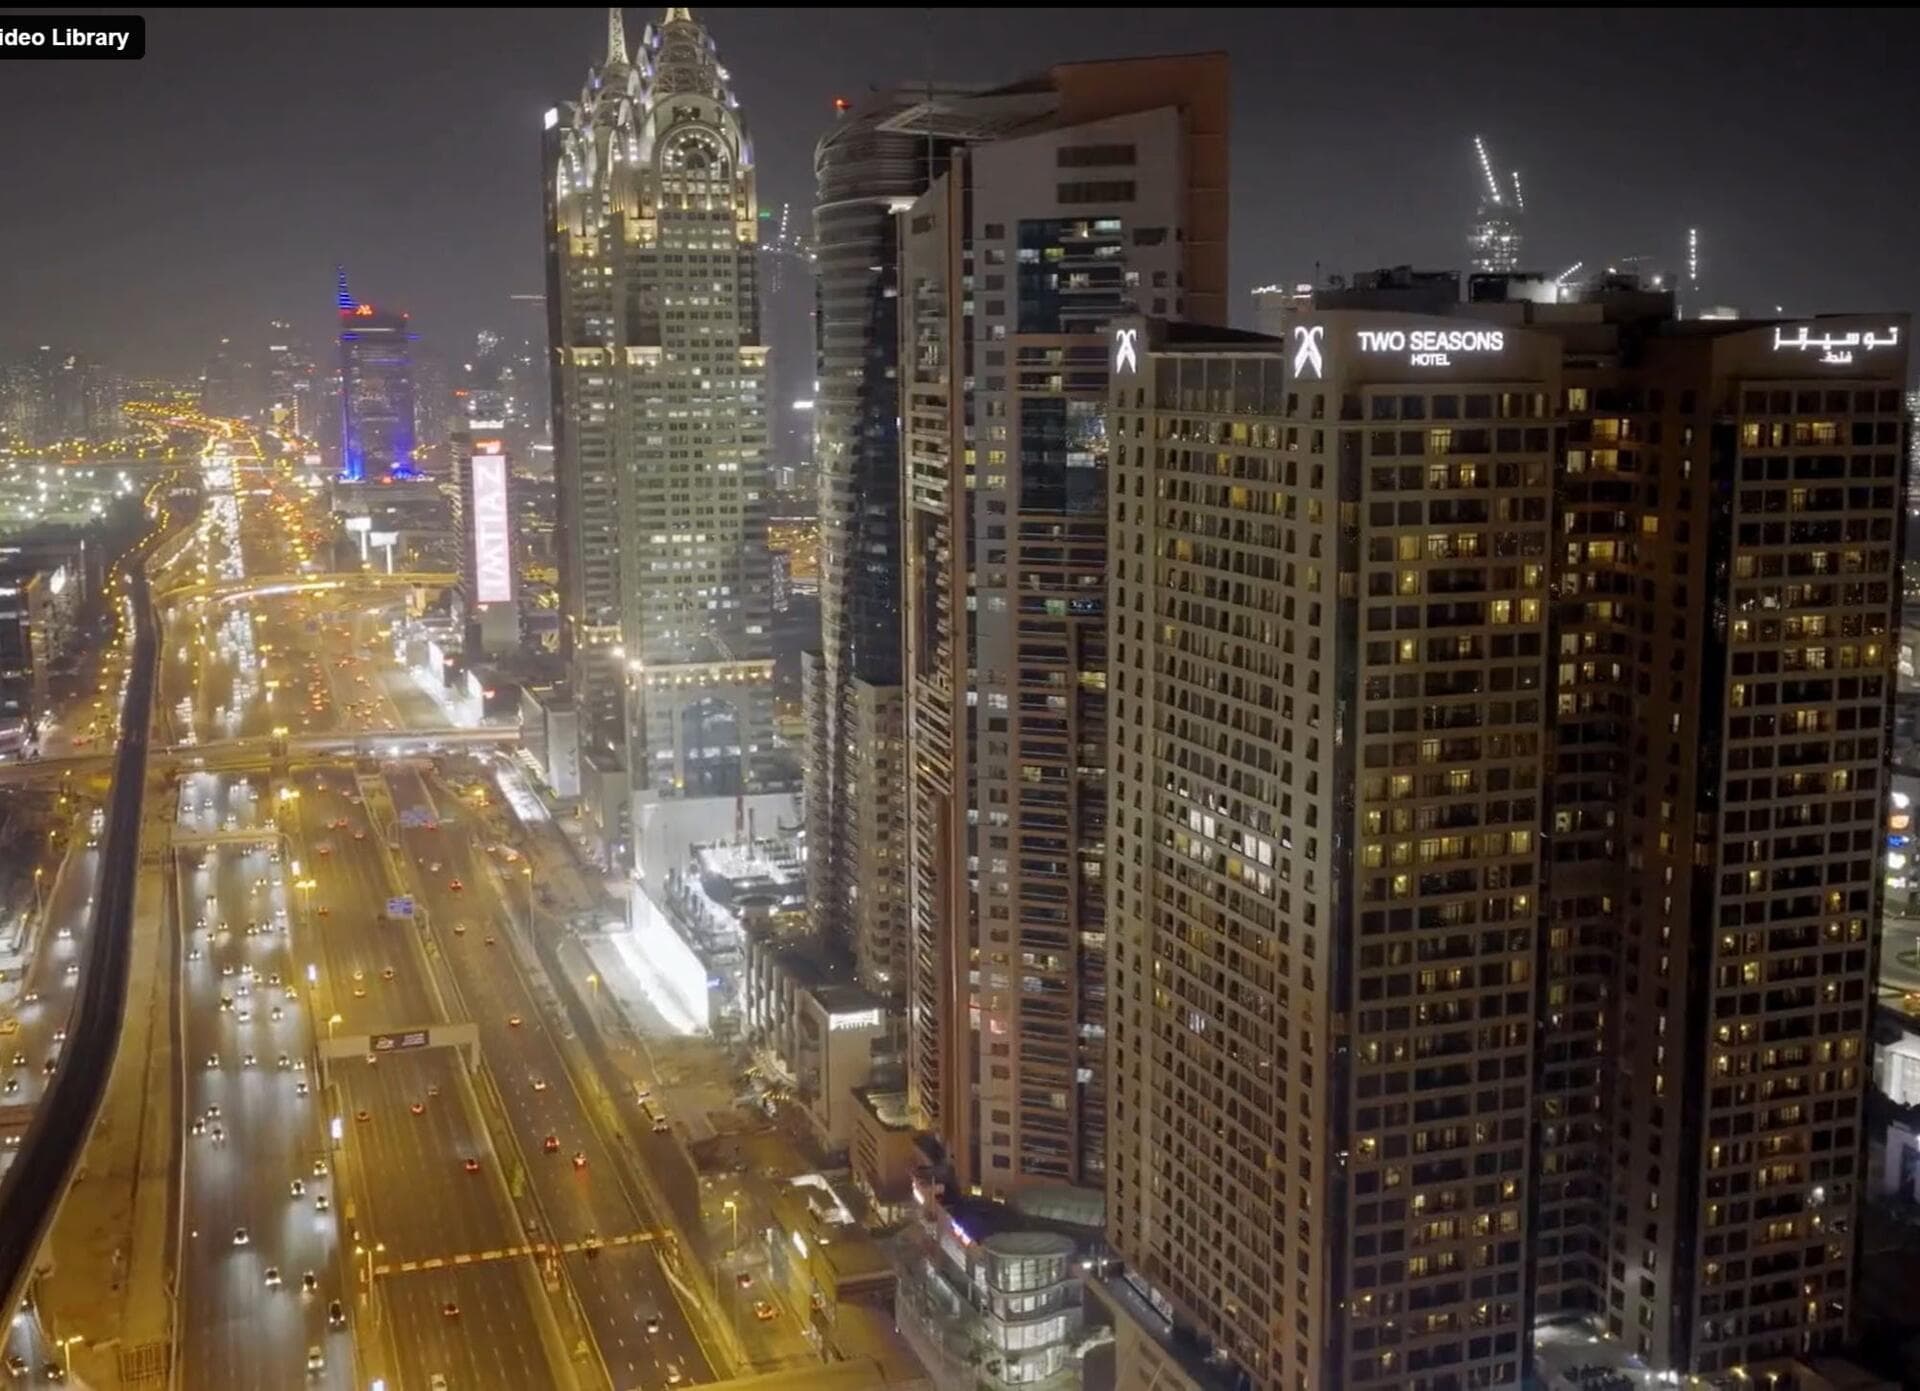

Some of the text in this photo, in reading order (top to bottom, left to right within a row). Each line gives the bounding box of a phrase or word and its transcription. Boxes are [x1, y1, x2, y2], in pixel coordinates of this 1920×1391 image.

[1357, 331, 1504, 351] TWO SEASONS
[1411, 354, 1450, 366] HOTEL
[477, 461, 506, 588] IMTIAZ
